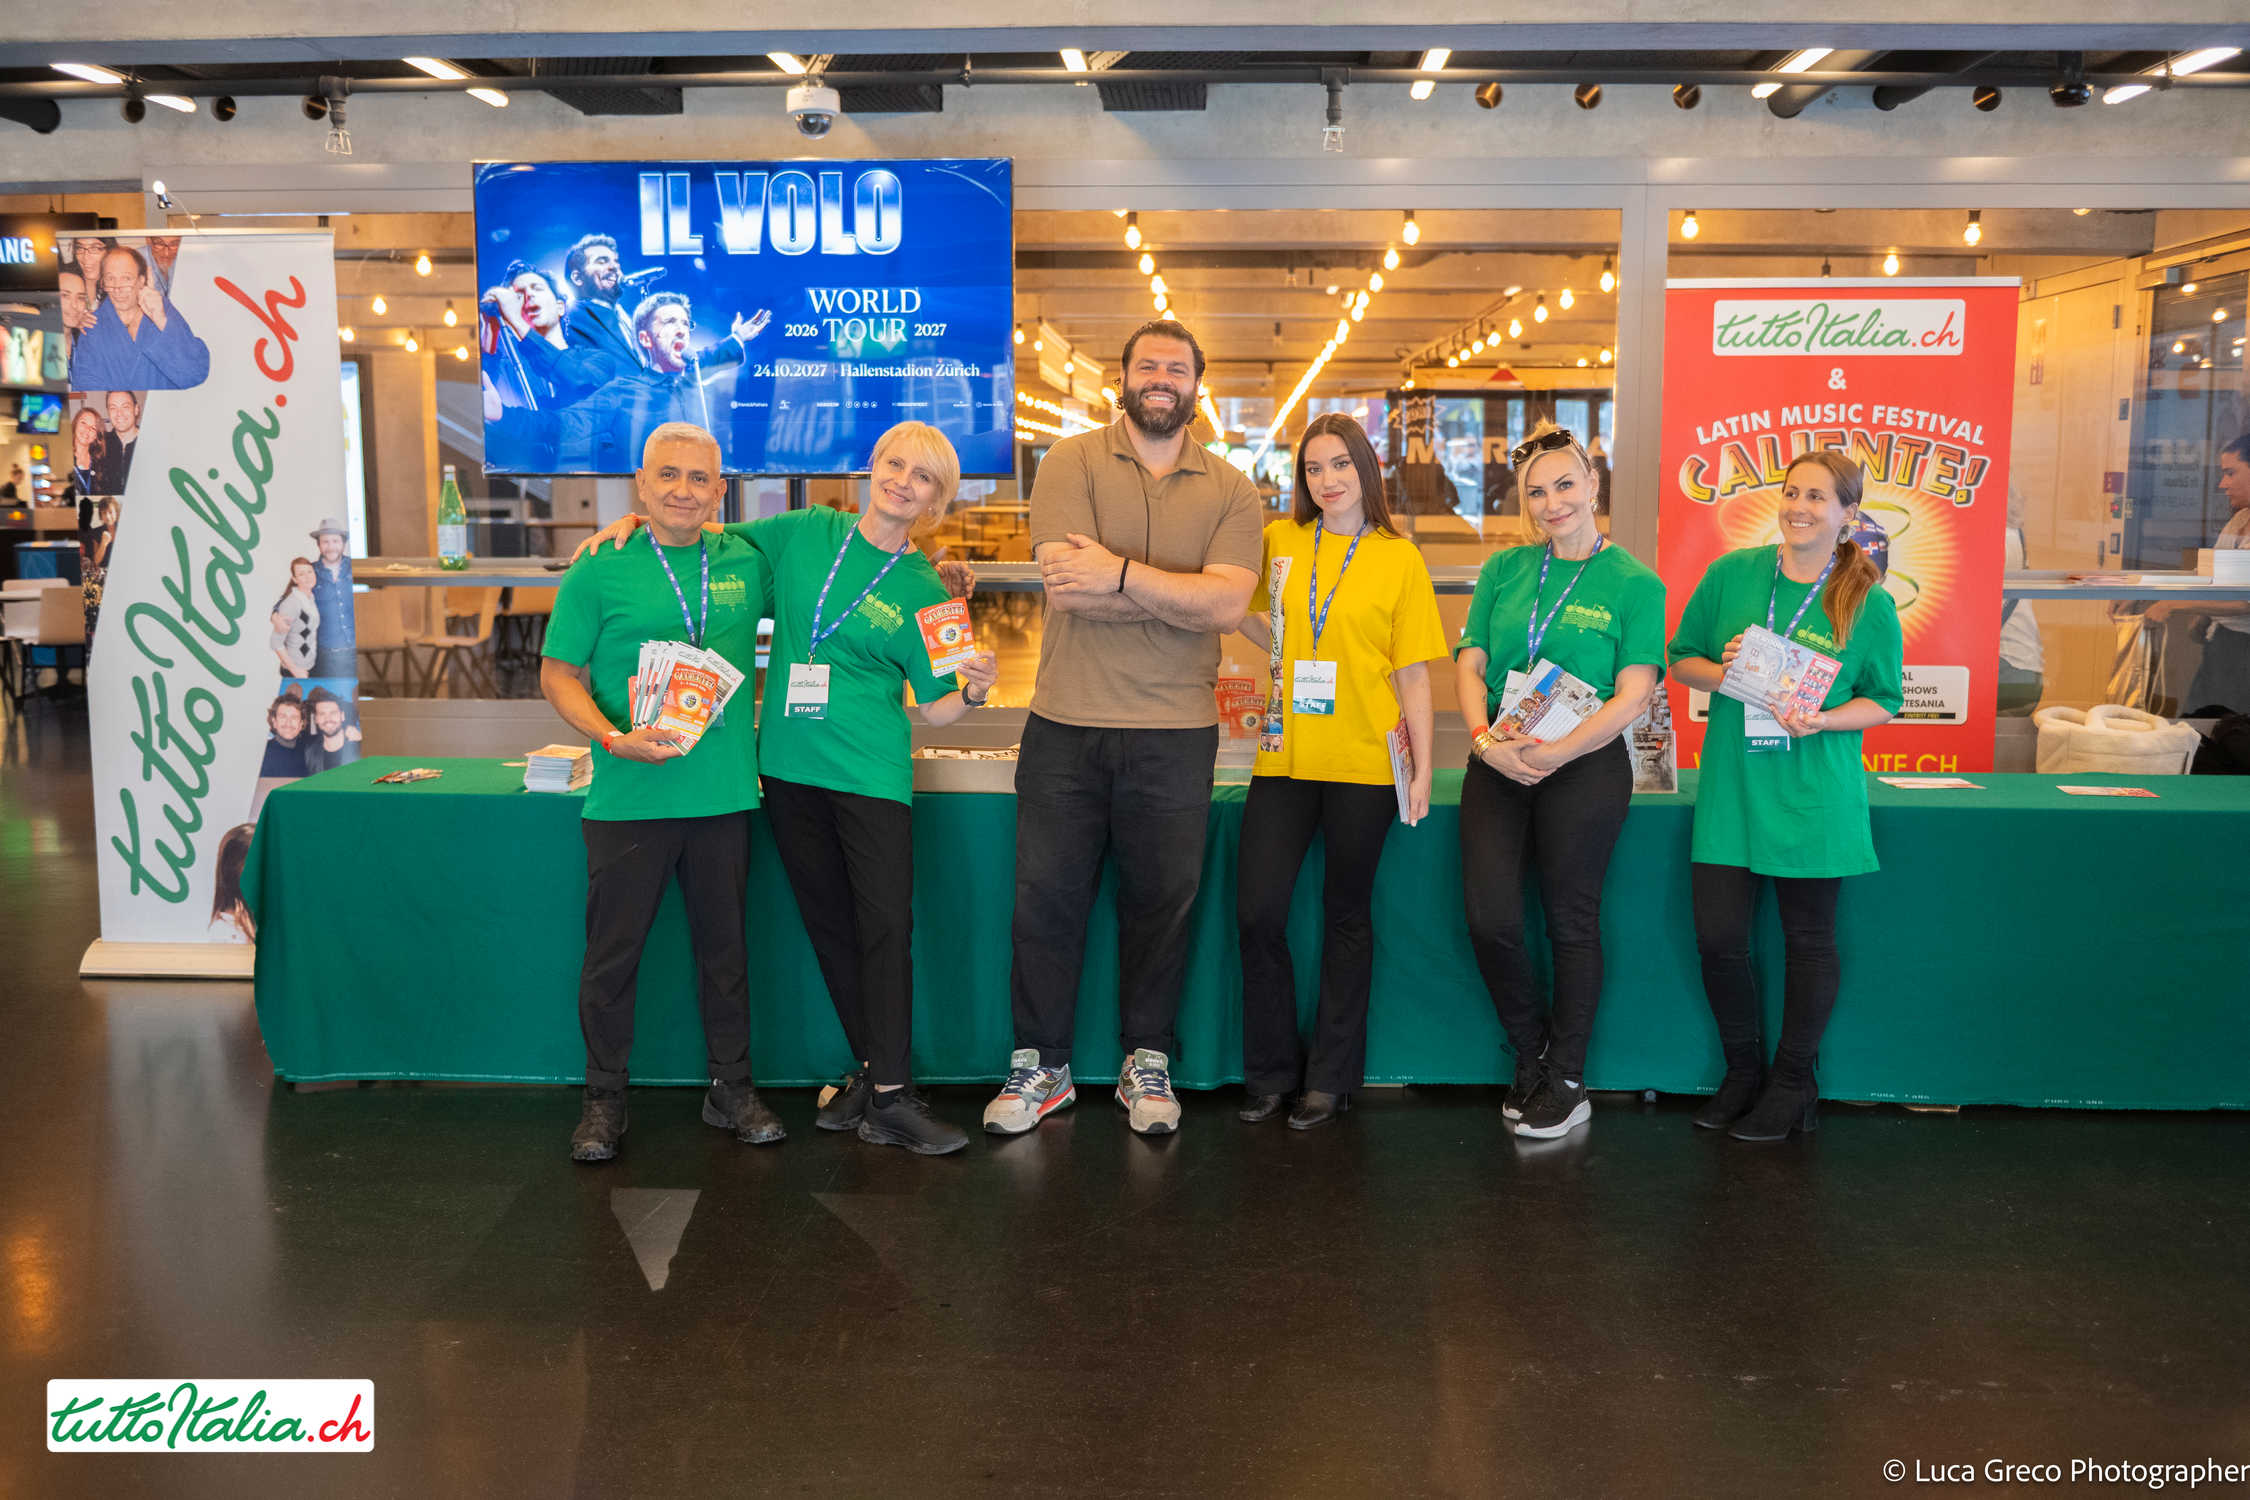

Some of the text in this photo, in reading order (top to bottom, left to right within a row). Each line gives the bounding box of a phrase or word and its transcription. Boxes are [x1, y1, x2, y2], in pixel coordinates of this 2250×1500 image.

[639, 170, 902, 256] IL VOLO
[808, 289, 922, 314] WORLD
[784, 318, 948, 343] 2026 TOUR 2027
[1716, 302, 1960, 353] tuttoItalia.ch
[753, 361, 981, 378] 24.10.2027 Hallenstadion Zürich
[1828, 368, 1847, 390] &
[1695, 403, 1985, 446] LATIN MUSIC FESTIVAL
[111, 275, 306, 903] tuttoItalia.ch
[1902, 671, 1914, 681] AL
[1902, 686, 1938, 695] SHOWS
[1902, 700, 1945, 708] TESANIA
